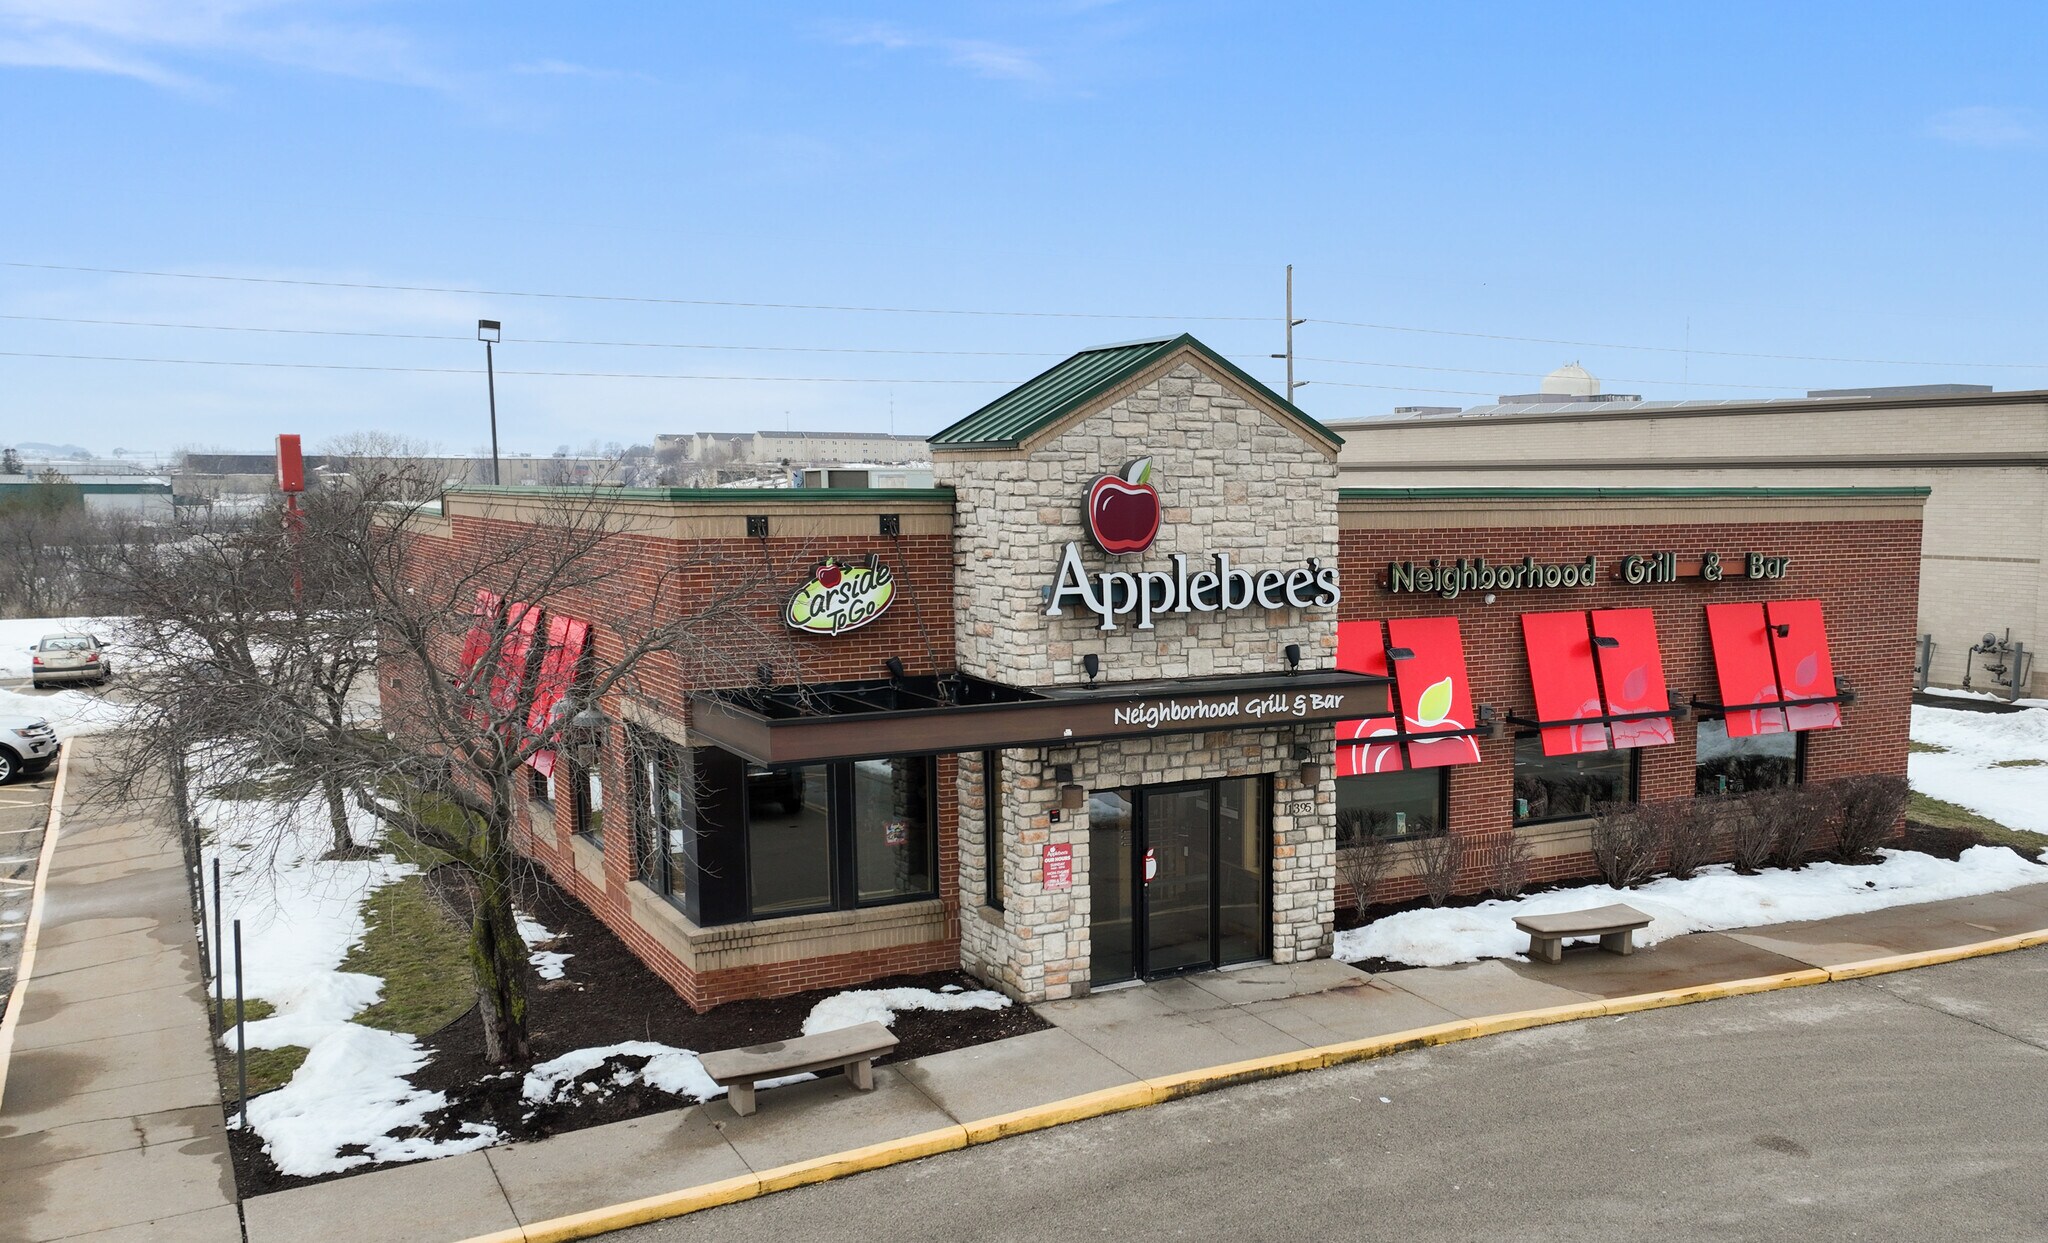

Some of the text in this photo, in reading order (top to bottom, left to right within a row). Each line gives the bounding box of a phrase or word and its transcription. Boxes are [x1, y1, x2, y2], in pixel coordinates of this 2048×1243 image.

[787, 555, 892, 626] Carside
[1045, 541, 1341, 630] Applebee's
[1391, 552, 1790, 599] Neighborhood Grill & Bar
[1114, 693, 1345, 728] Neighborhood Grill & Bar
